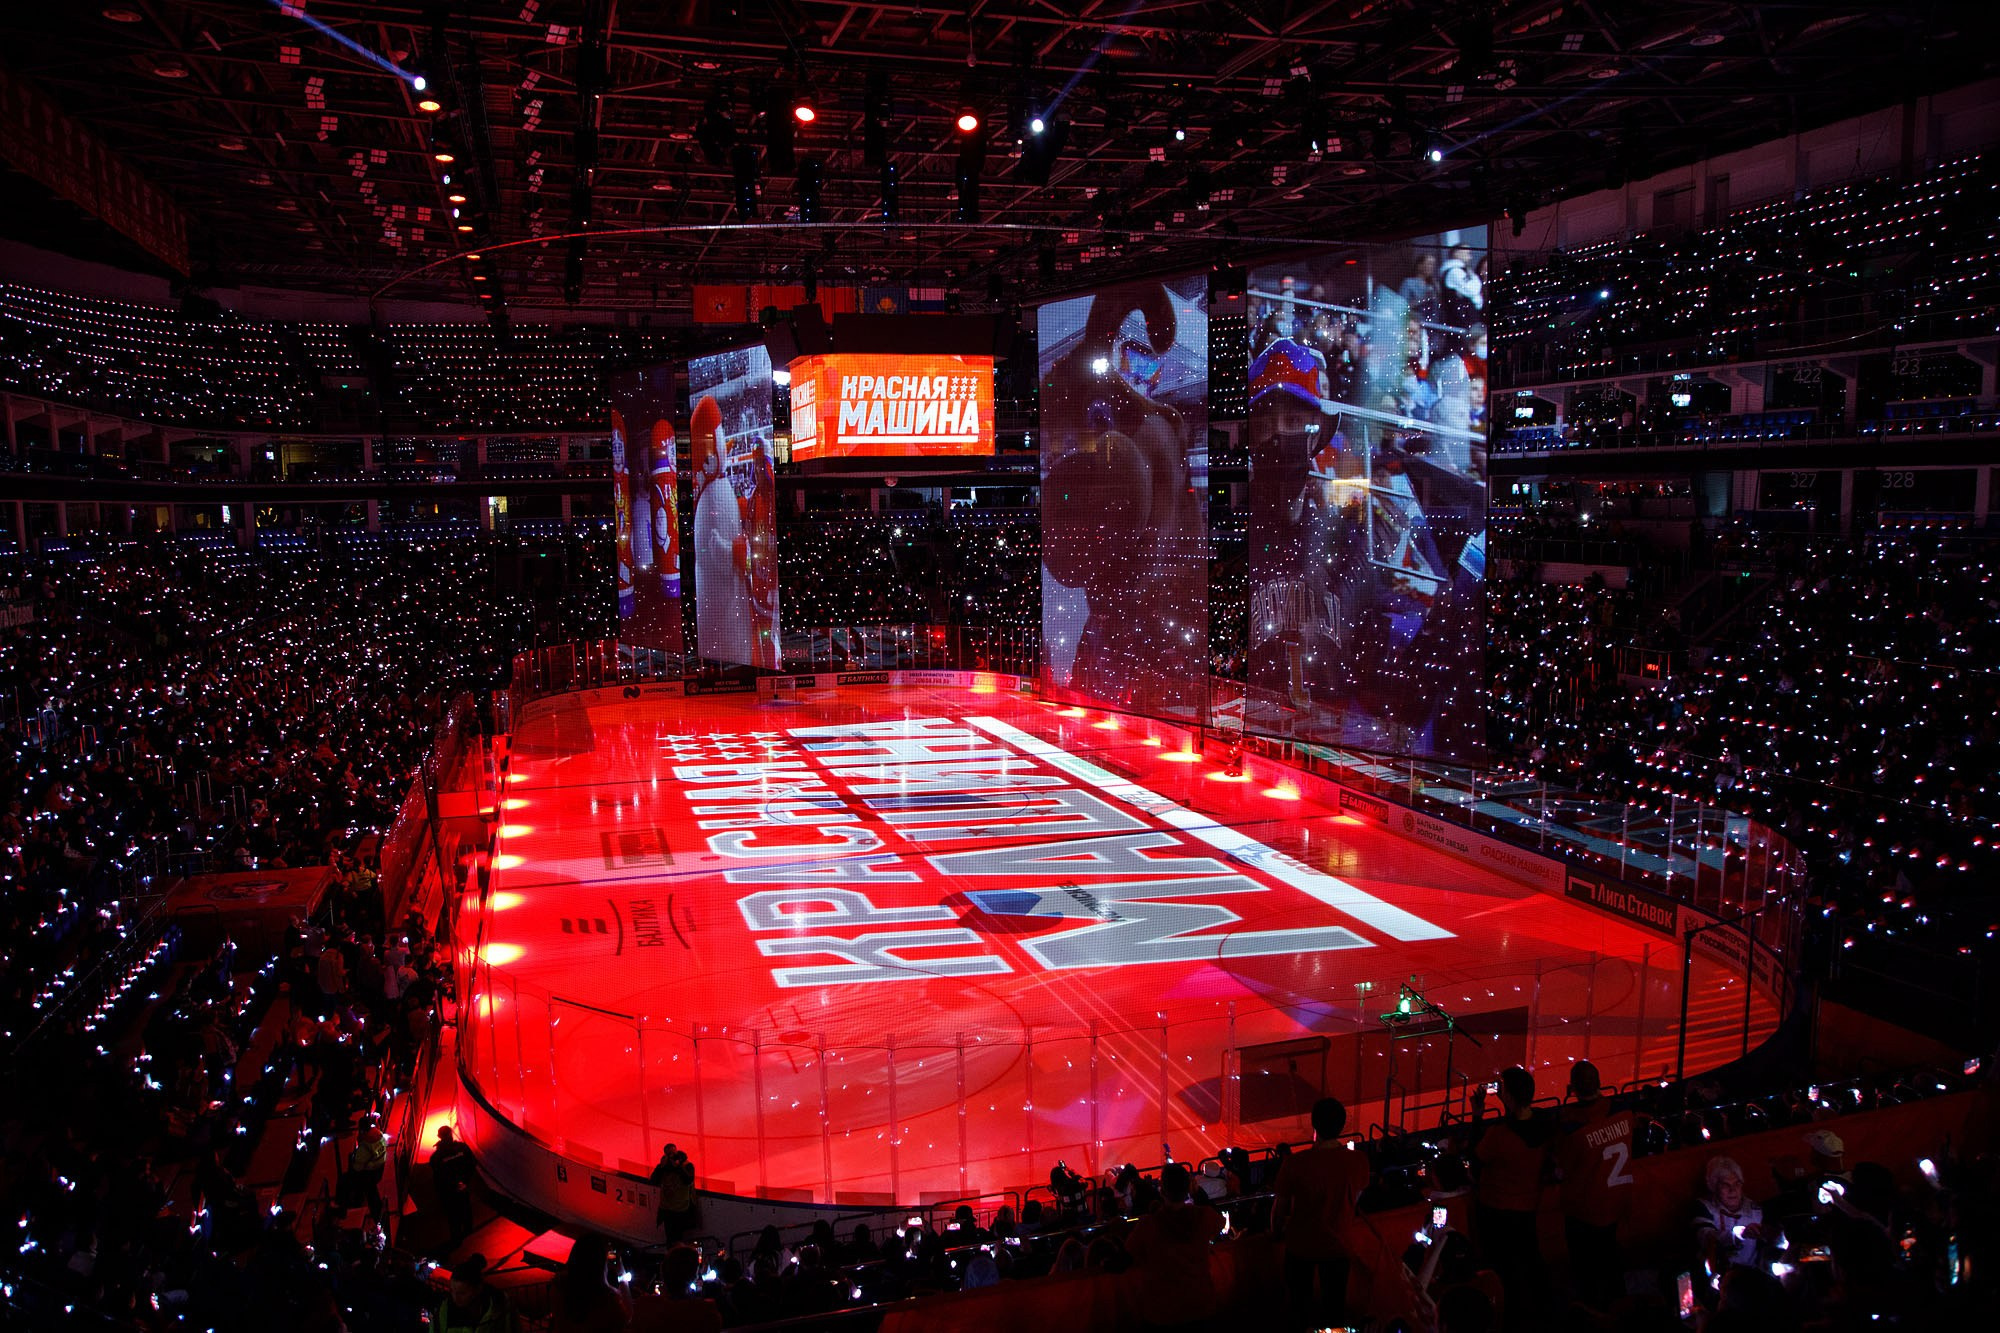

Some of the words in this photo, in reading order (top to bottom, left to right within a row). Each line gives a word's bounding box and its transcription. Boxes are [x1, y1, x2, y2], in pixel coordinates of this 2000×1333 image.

[1793, 367, 1822, 384] 422
[1891, 358, 1920, 376] 423
[841, 375, 948, 400] КРАСНАЯ
[1667, 381, 1690, 395] 421
[837, 400, 979, 435] МАШИНА
[1790, 472, 1817, 489] 327
[1882, 472, 1915, 489] 328
[1416, 817, 1444, 833] БАЛЬЗАМ
[786, 717, 1379, 971] МАШИНА
[1416, 827, 1444, 844] ЗОЛОТАЯ
[1445, 838, 1469, 852] ЗВЕЗДА
[671, 760, 1015, 988] КРАСНАЯ
[1597, 883, 1626, 911] ЛИГА
[1627, 893, 1674, 929] СТАВОК
[629, 898, 665, 948] БАЛТИКА
[1602, 1141, 1634, 1188] 2
